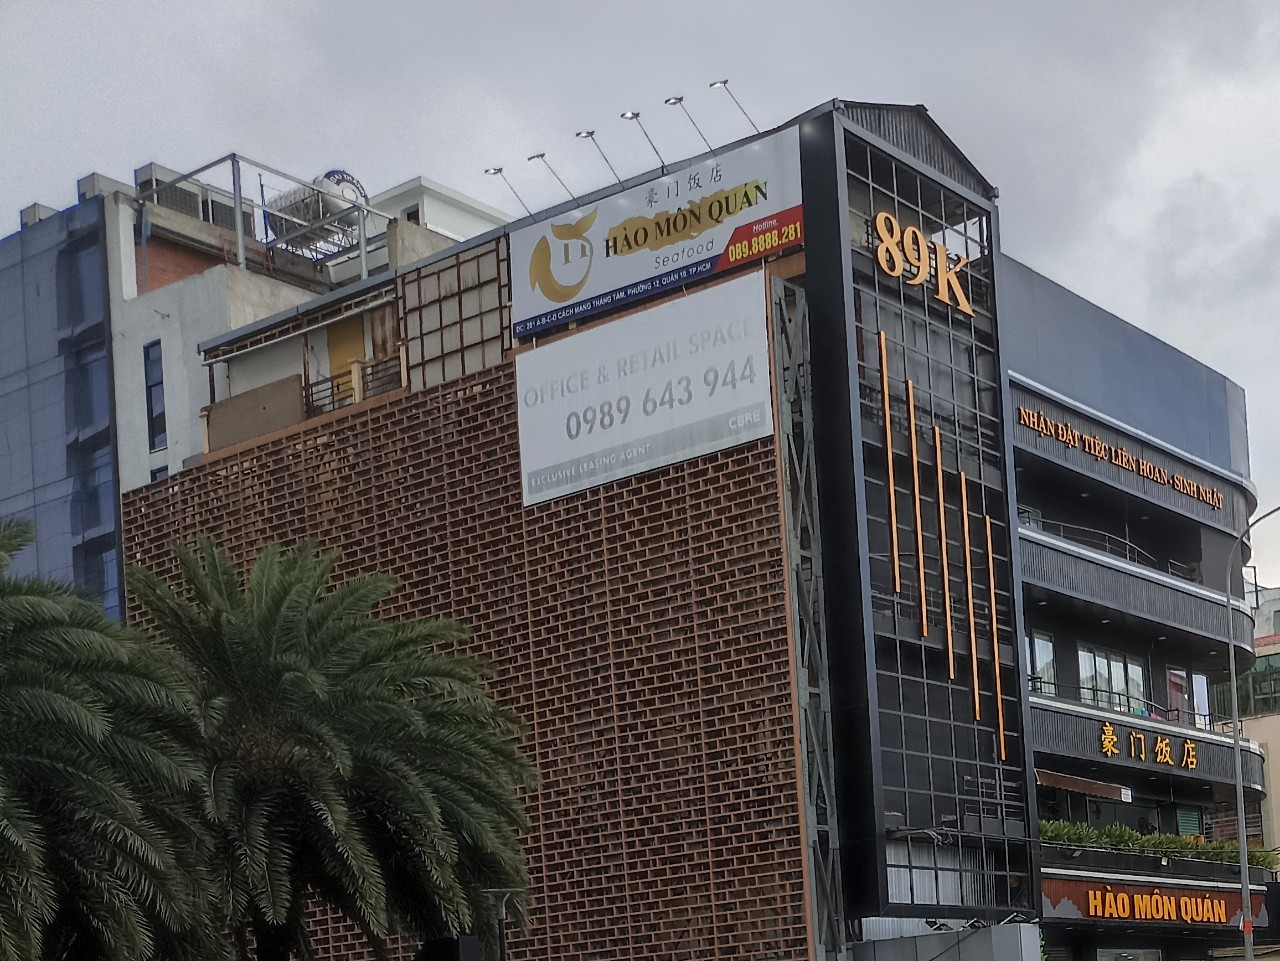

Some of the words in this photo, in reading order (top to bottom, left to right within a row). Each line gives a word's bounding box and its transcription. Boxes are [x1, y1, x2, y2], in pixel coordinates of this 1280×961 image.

[645, 162, 724, 208] 豪门饭店
[605, 223, 649, 258] HÀO
[654, 206, 701, 241] MÔN
[708, 181, 769, 224] QUÁN
[728, 221, 801, 262] 089.8888.281
[654, 238, 714, 269] Seafood
[875, 212, 976, 318] 89K
[557, 307, 574, 322] CÁCH
[592, 294, 613, 308] THÁNG
[523, 369, 590, 409] OFFICE
[597, 364, 610, 385] &
[616, 341, 681, 379] RETAIL
[565, 395, 632, 440] 0989
[642, 375, 694, 417] 643
[703, 354, 757, 397] 944
[728, 409, 761, 430] CBRE
[531, 467, 577, 488] EXCLUSIVE
[579, 453, 617, 474] LEASING
[620, 443, 650, 461] AGENT
[1139, 459, 1168, 485] HOAN
[1173, 474, 1198, 499] SINH
[1100, 721, 1199, 770] 豪门饭店
[1088, 885, 1131, 918] HÀO
[1133, 888, 1177, 921] MÔN
[1180, 893, 1227, 924] QUÁN
